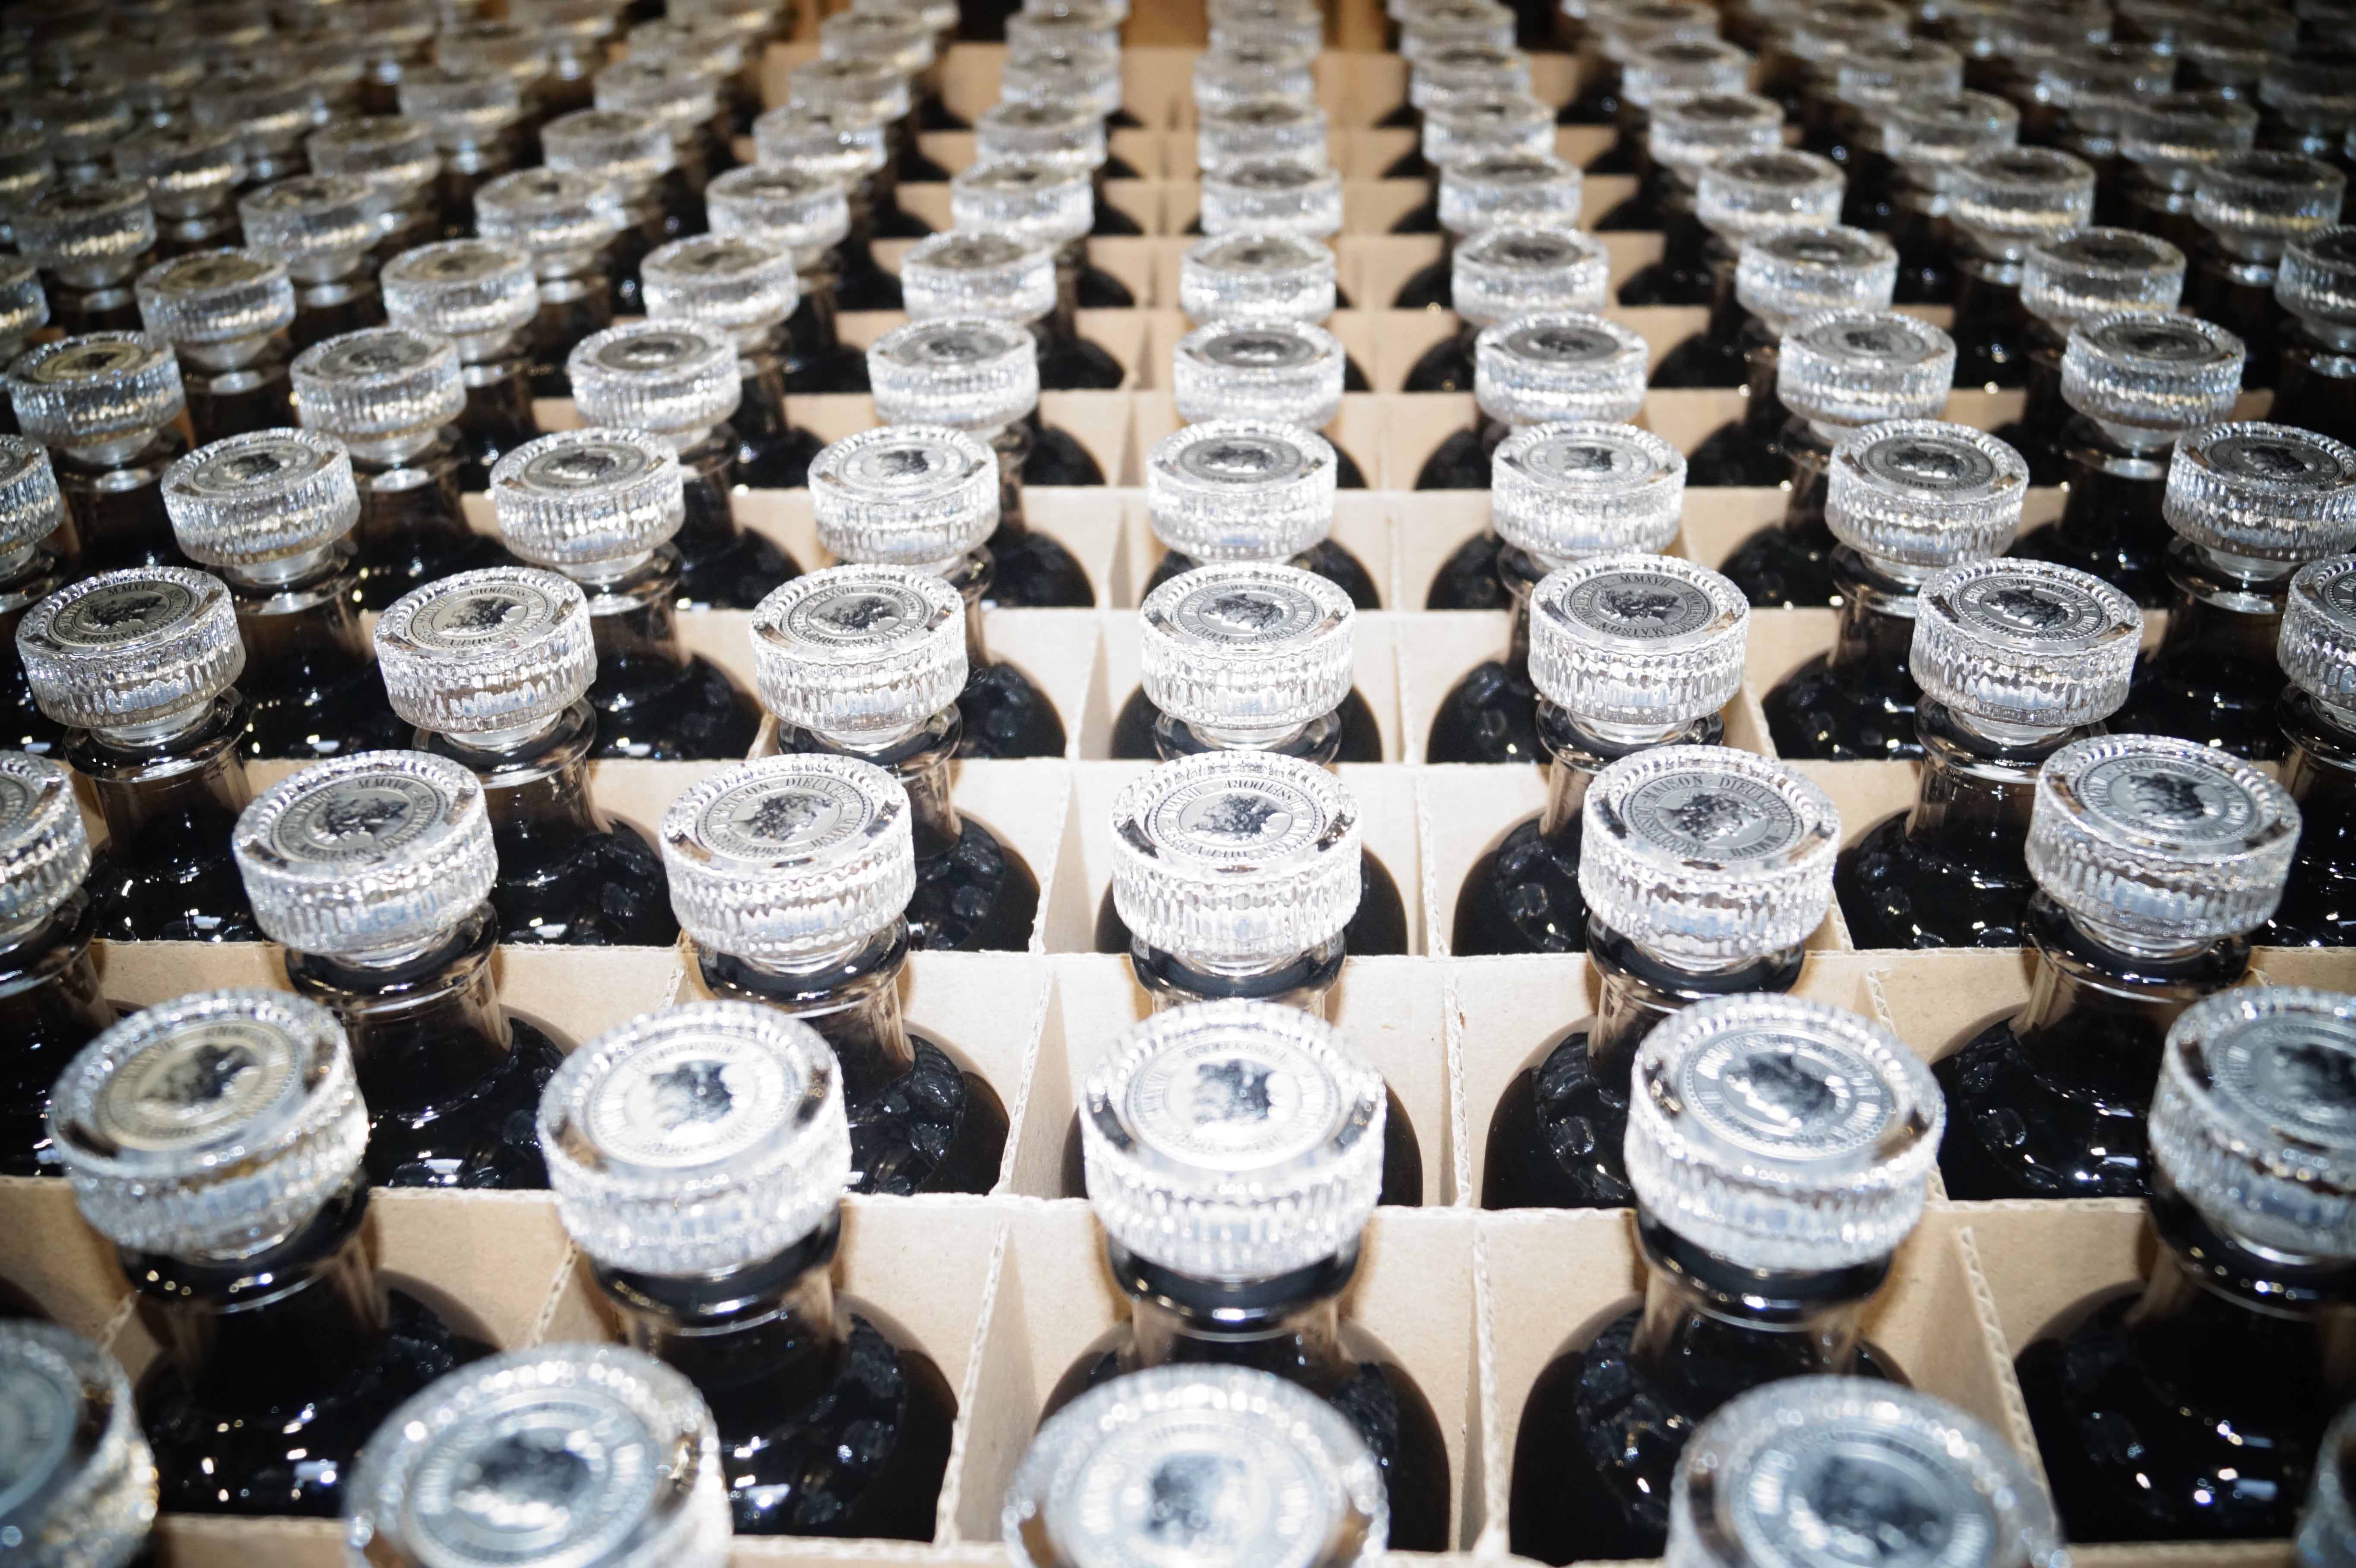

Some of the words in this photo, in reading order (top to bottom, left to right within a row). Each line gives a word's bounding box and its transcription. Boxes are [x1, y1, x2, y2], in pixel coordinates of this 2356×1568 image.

[1620, 575, 1672, 587] MMXVII
[1599, 621, 1665, 636] MAISON
[713, 780, 770, 817] MAISON
[785, 776, 835, 790] DIEUX
[1641, 774, 1703, 801] MAISON
[1720, 775, 1774, 801] DIEUX
